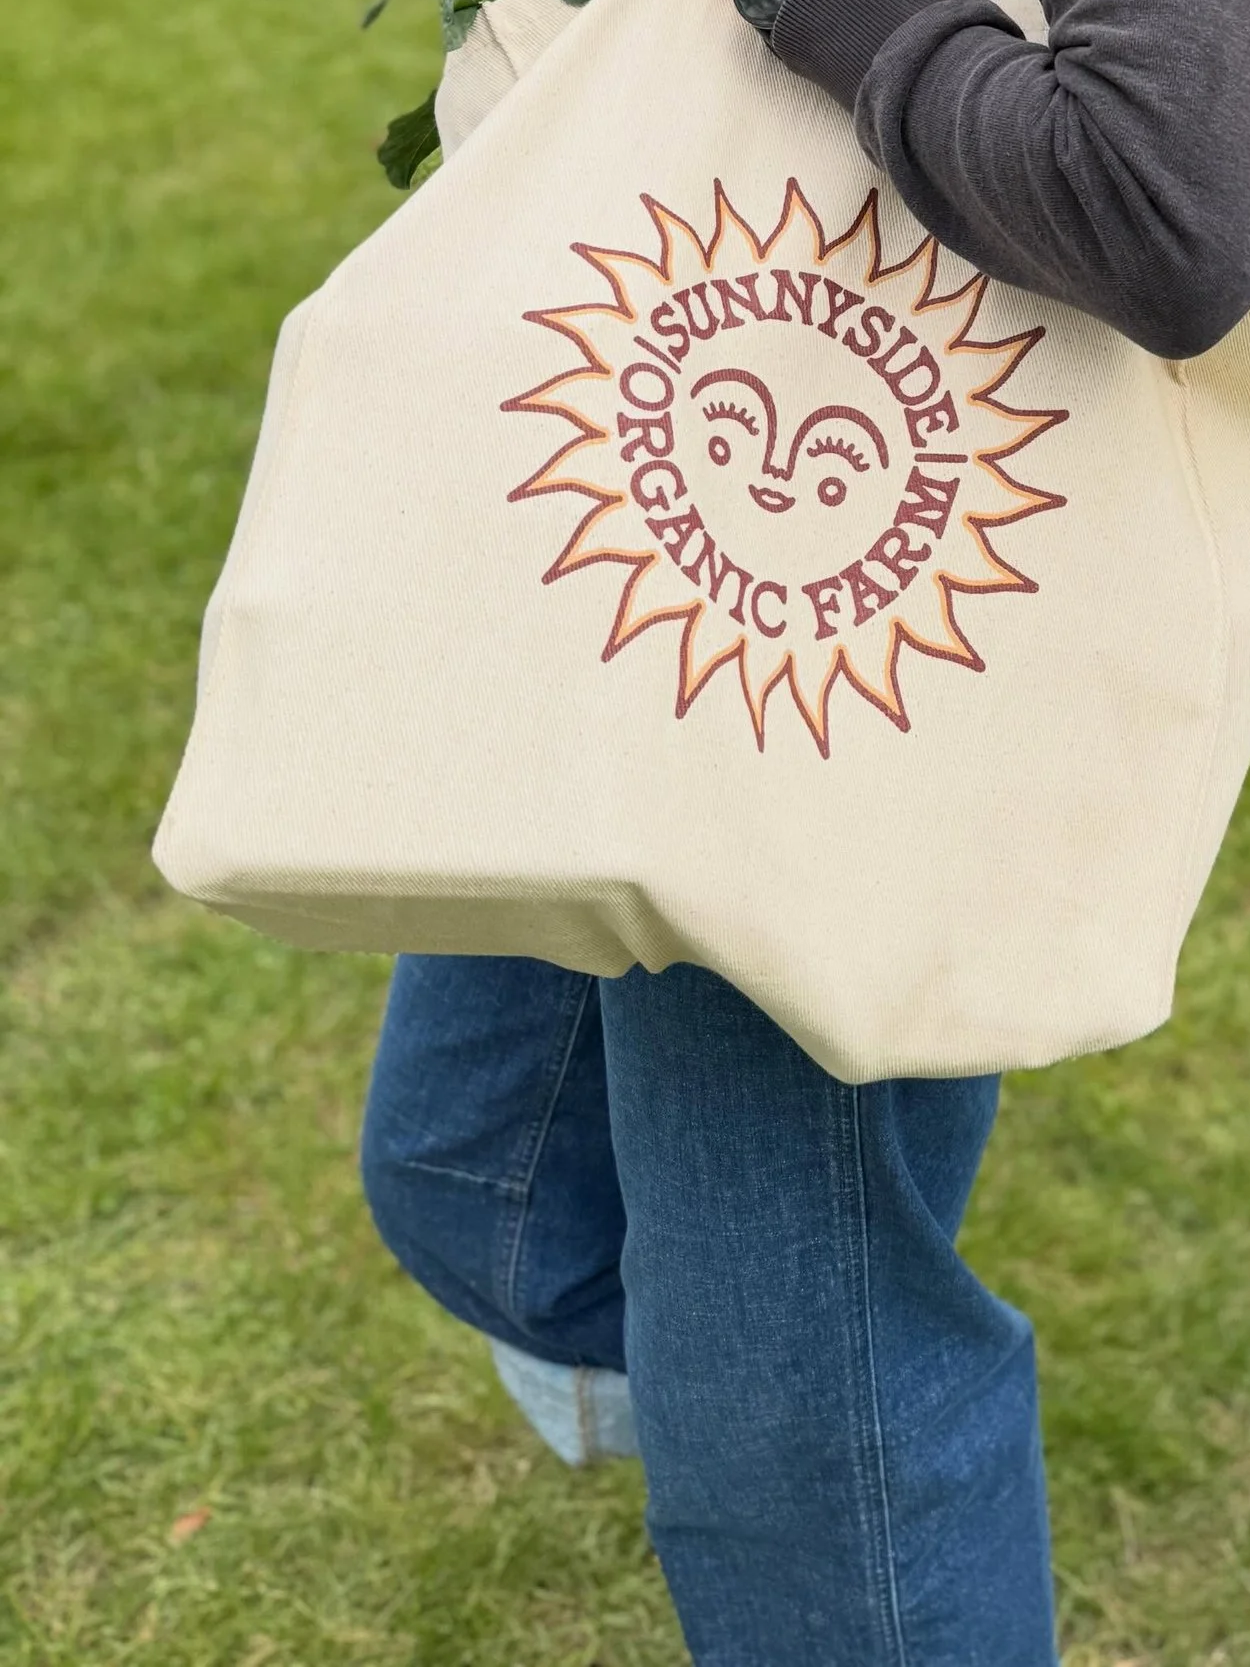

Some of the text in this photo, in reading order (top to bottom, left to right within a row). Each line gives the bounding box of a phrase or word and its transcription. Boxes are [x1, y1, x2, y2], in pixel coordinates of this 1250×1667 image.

[651, 269, 960, 448] SUNNYSIDE
[616, 361, 961, 641] ORGANIC FARM
